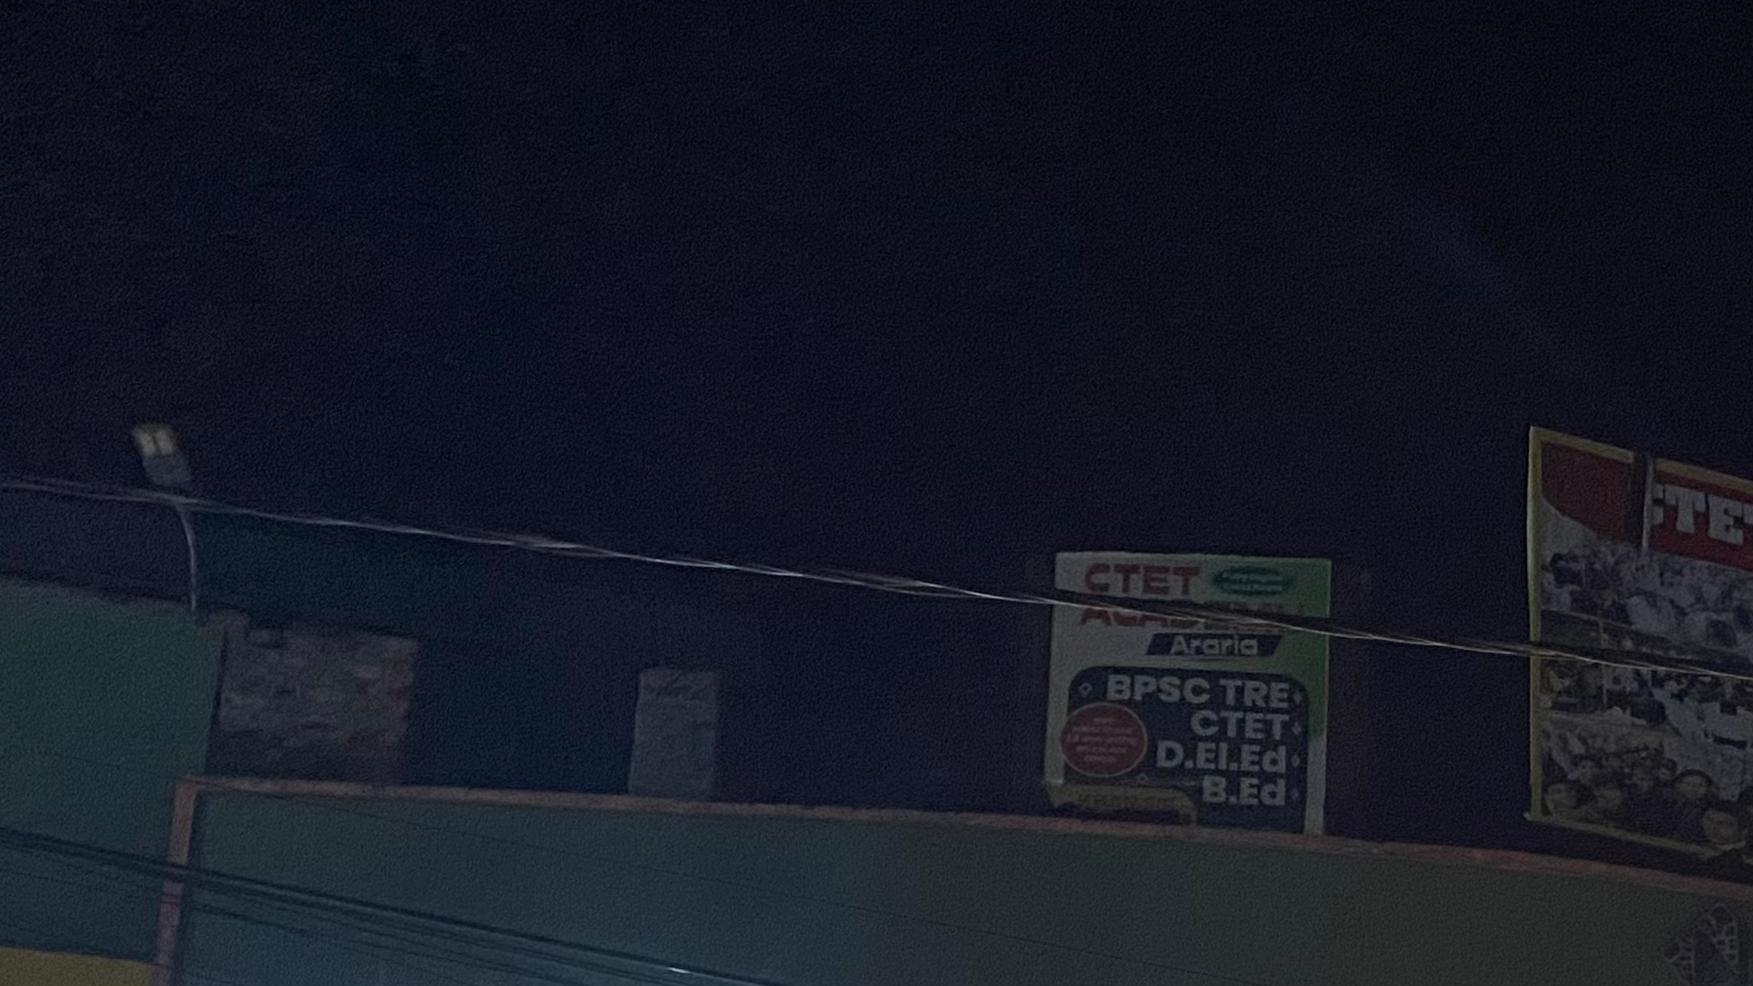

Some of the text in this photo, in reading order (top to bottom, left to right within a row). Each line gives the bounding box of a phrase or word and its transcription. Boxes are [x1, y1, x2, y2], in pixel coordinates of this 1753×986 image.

[1085, 562, 1200, 596] CTET
[1169, 634, 1259, 656] Araria
[1107, 673, 1291, 709] BPSC TRE
[1189, 709, 1291, 741] CTET
[1155, 739, 1287, 774] D.El.Ed
[1201, 774, 1287, 807] B.Ed
